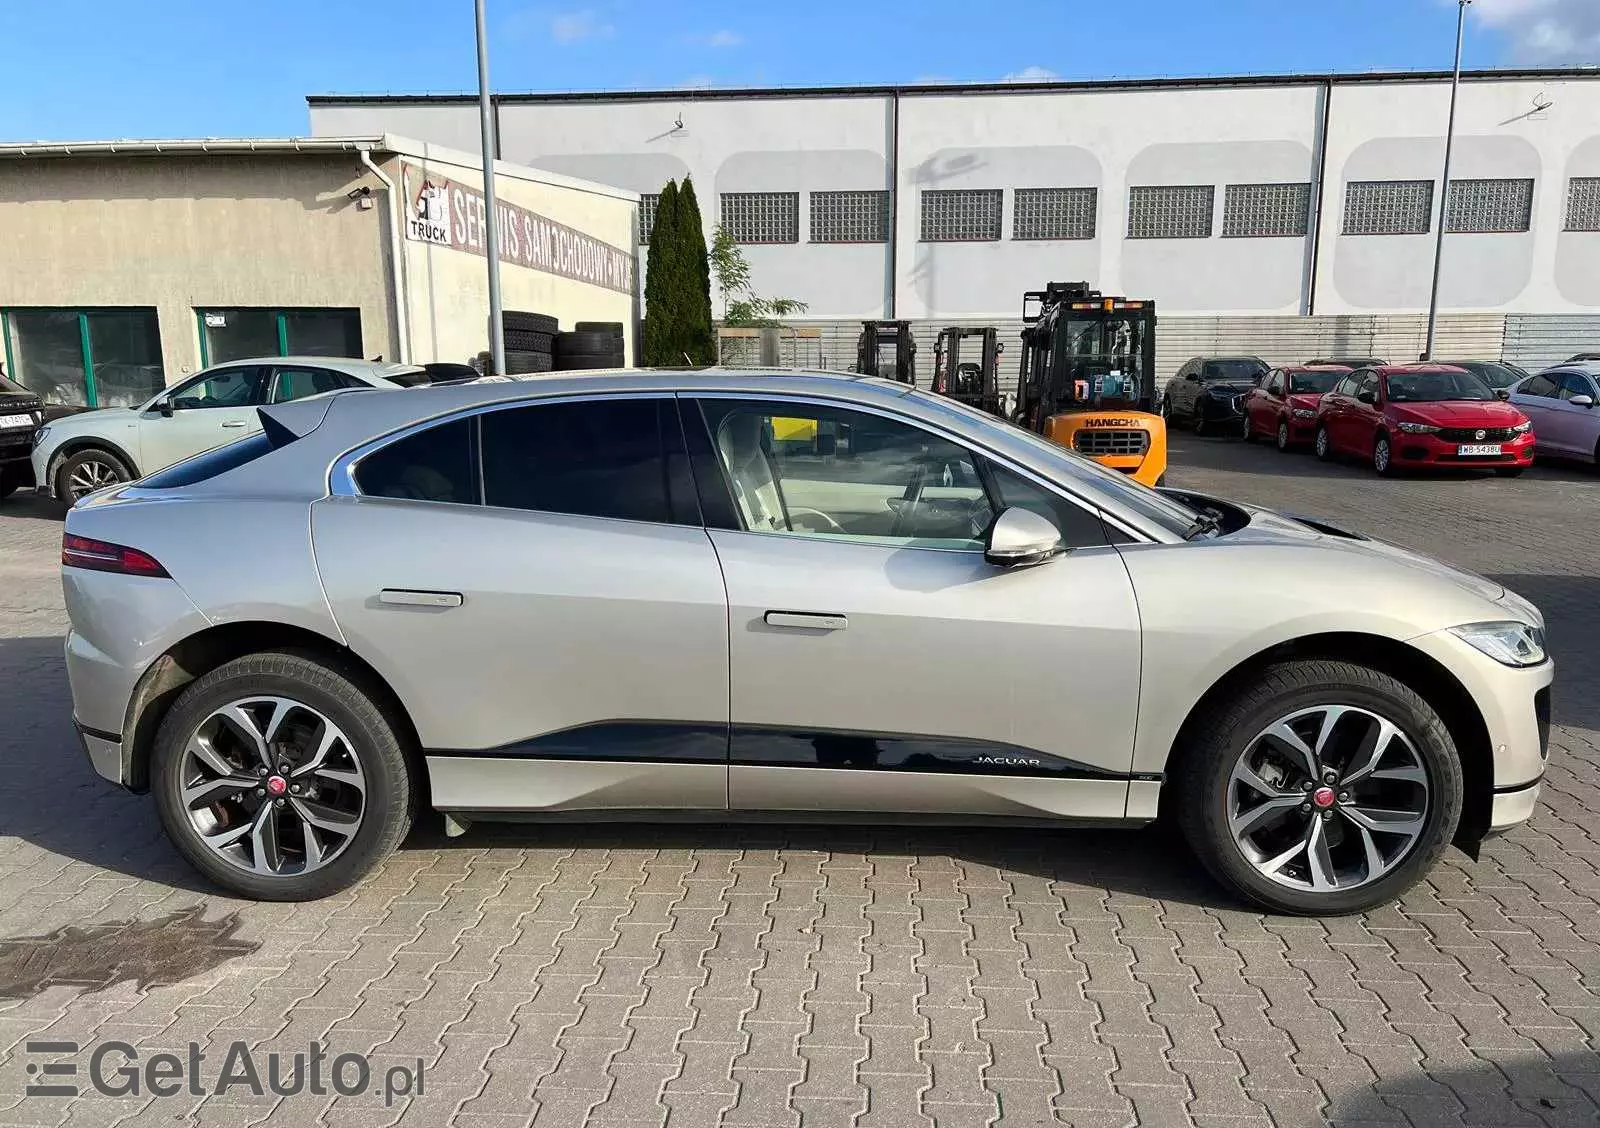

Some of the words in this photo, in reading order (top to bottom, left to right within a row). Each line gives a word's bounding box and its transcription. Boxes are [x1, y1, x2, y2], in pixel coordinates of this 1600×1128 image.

[410, 220, 447, 242] TRUCK
[1085, 418, 1141, 428] HANGCHA
[972, 756, 1041, 766] JAGUAR
